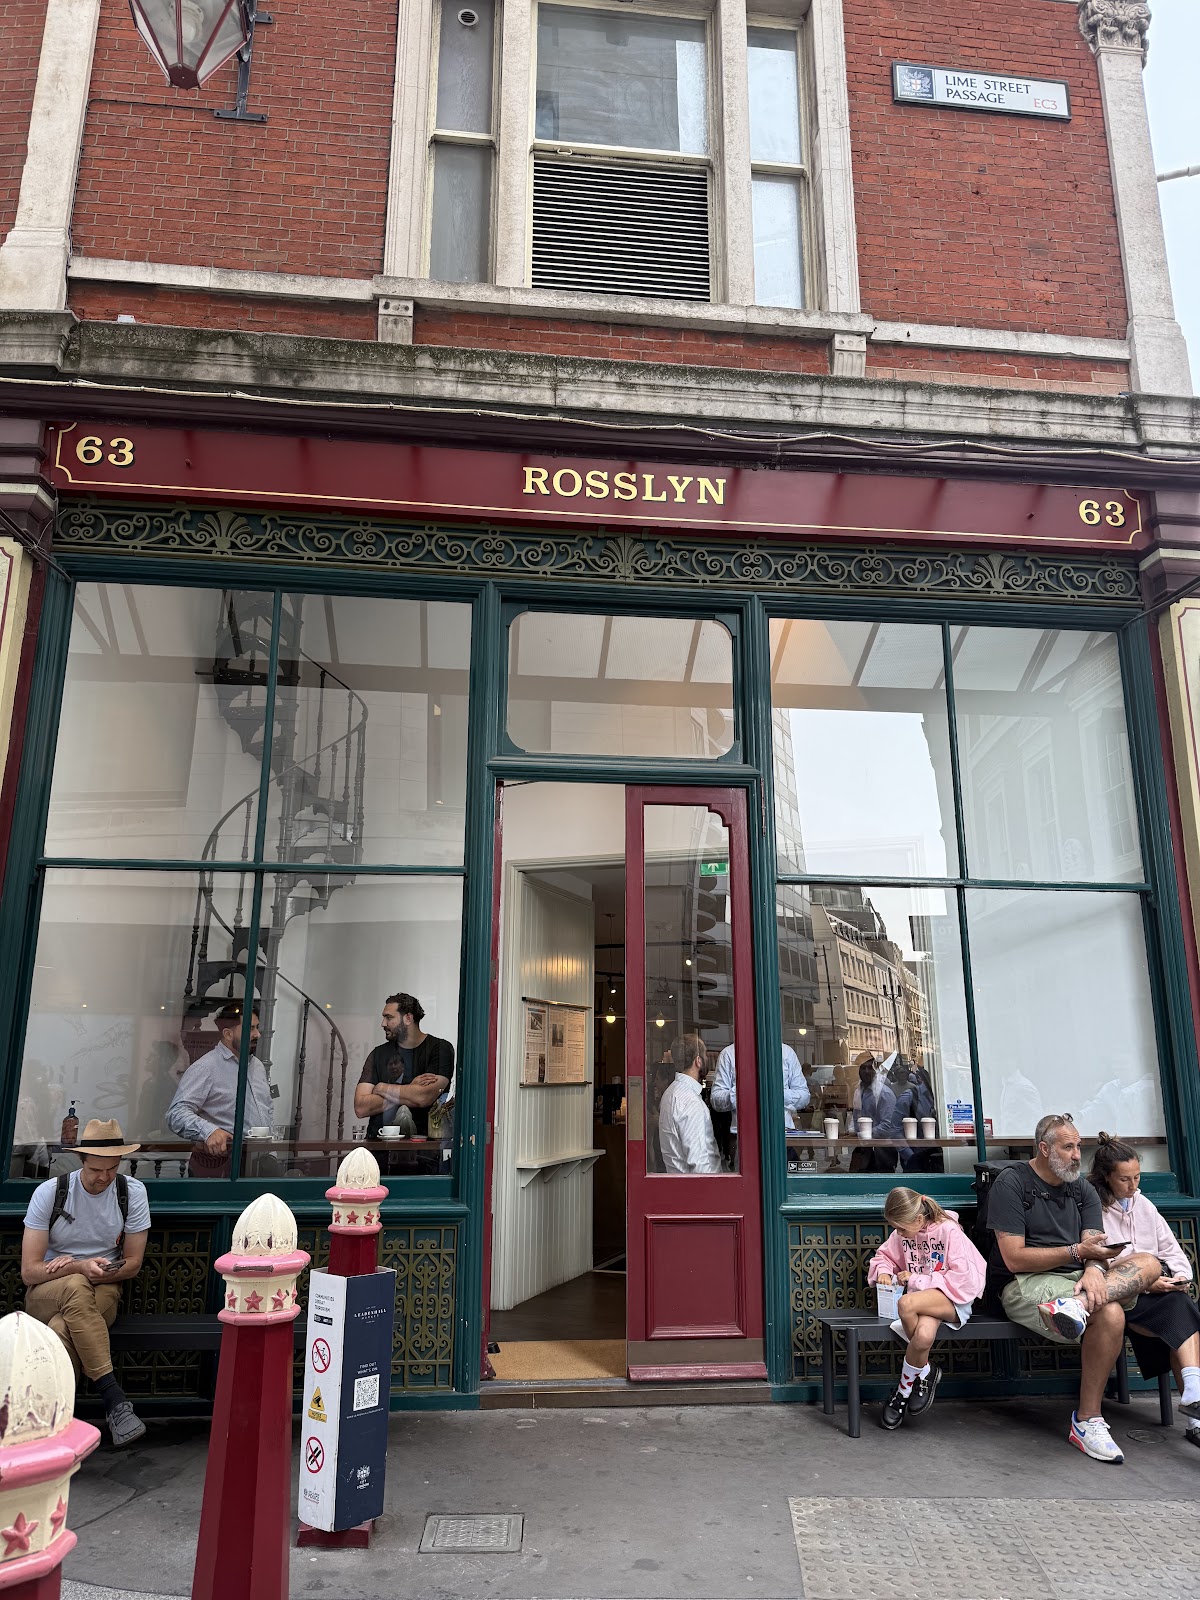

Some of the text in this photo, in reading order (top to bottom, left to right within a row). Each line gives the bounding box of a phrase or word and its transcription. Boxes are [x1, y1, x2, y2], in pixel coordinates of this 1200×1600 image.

[945, 75, 1032, 95] LIME STREET
[945, 88, 1006, 104] PASSAGE
[1033, 98, 1058, 110] EC3
[75, 436, 135, 467] 63
[522, 466, 727, 505] ROSSLYN
[1078, 499, 1126, 527] 63
[922, 1237, 945, 1254] York
[907, 1262, 925, 1273] For
